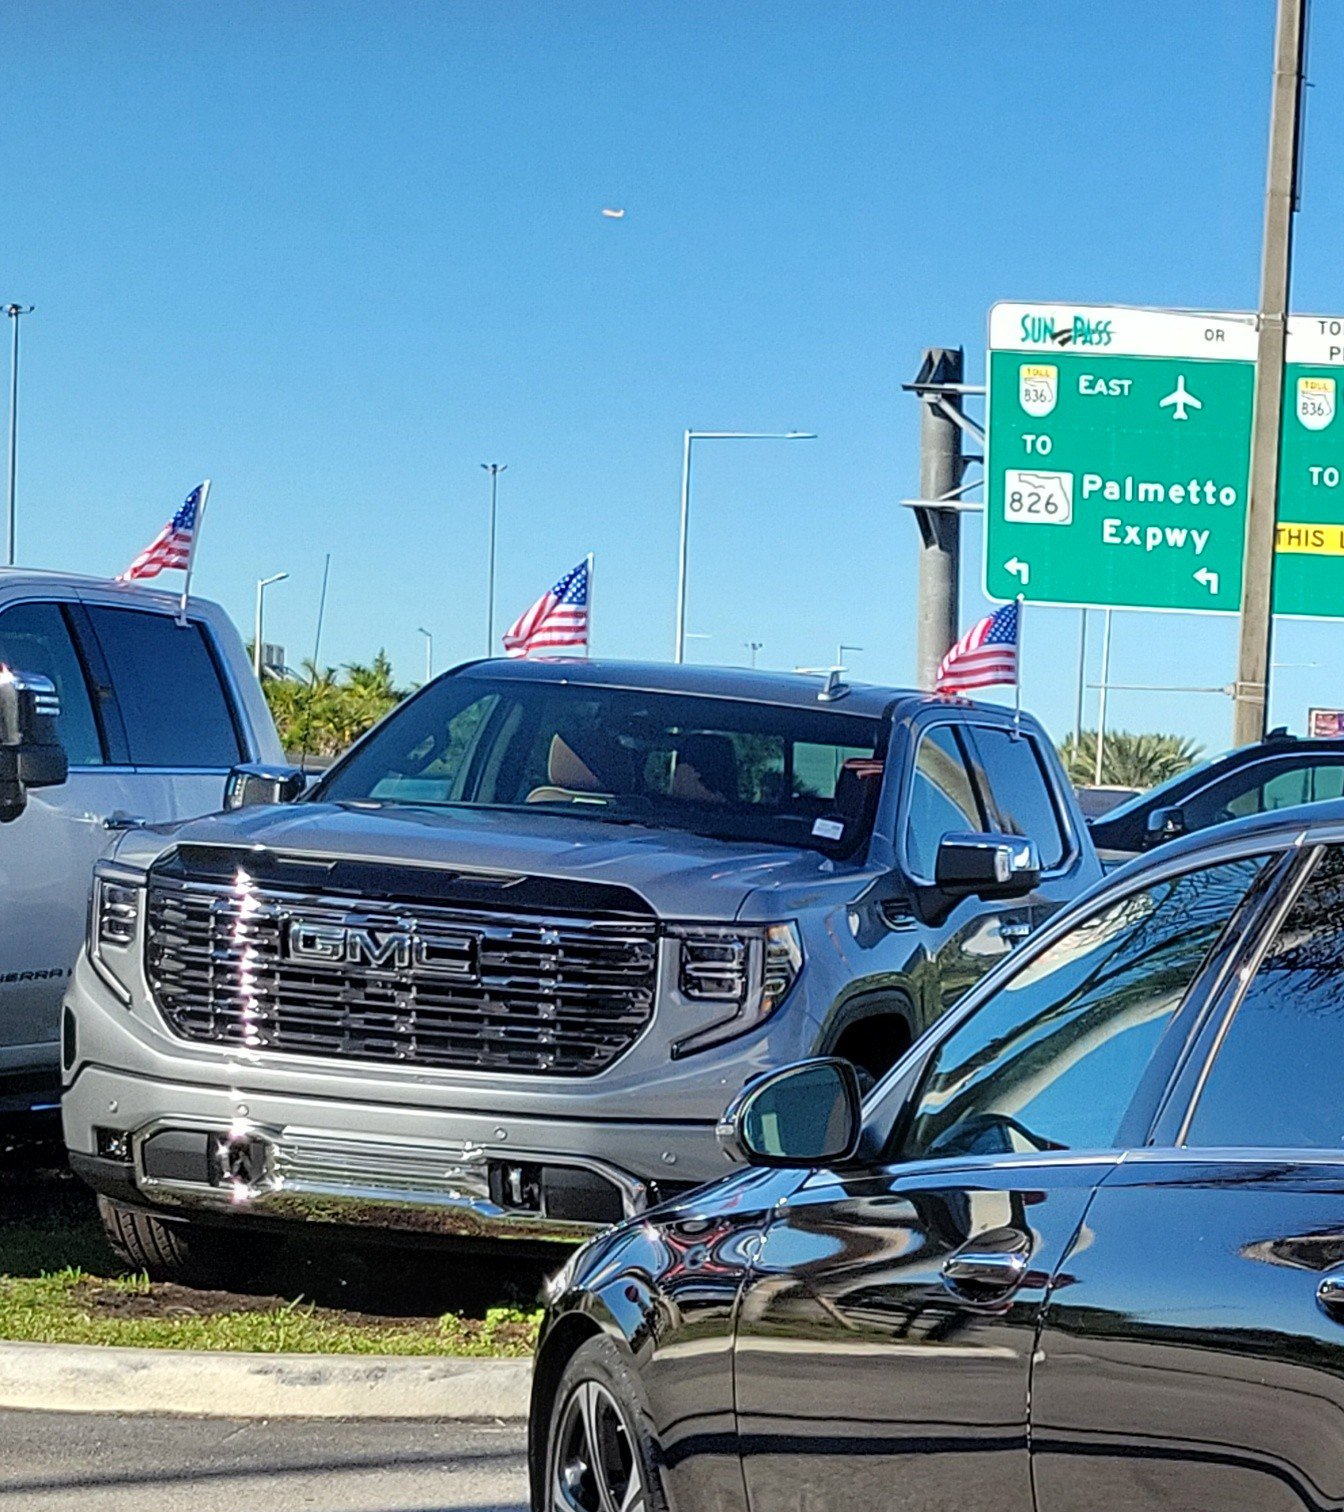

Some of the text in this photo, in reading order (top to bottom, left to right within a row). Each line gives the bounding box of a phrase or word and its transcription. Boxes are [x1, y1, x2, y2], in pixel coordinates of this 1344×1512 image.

[1204, 328, 1226, 342] OR
[1024, 388, 1048, 403] 836
[1078, 374, 1133, 397] EAST
[1301, 401, 1325, 417] 836
[1021, 434, 1053, 456] TO
[1308, 466, 1340, 488] TO
[1082, 473, 1237, 507] Palmetto
[1009, 490, 1059, 515] 826
[1102, 518, 1211, 555] Expwy
[1276, 528, 1325, 548] THIS
[288, 920, 474, 973] GMC
